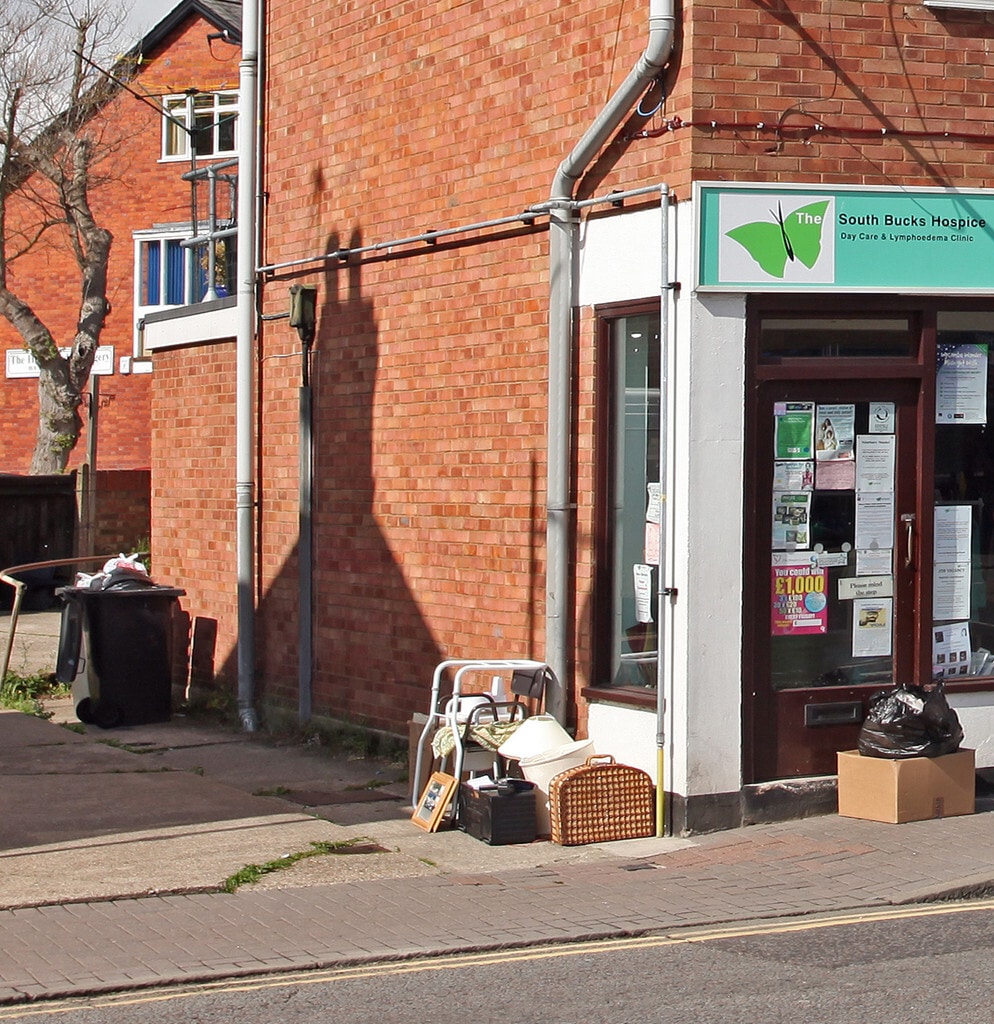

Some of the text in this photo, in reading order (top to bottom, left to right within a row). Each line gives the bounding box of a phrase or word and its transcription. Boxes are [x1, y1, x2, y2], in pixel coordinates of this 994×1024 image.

[796, 213, 986, 230] The South Bucks Hospice
[841, 233, 857, 241] Day
[890, 234, 948, 242] Lymphoedema
[950, 234, 973, 242] Clinic
[775, 568, 789, 576] You
[789, 567, 810, 576] could
[775, 575, 825, 595] £1,000
